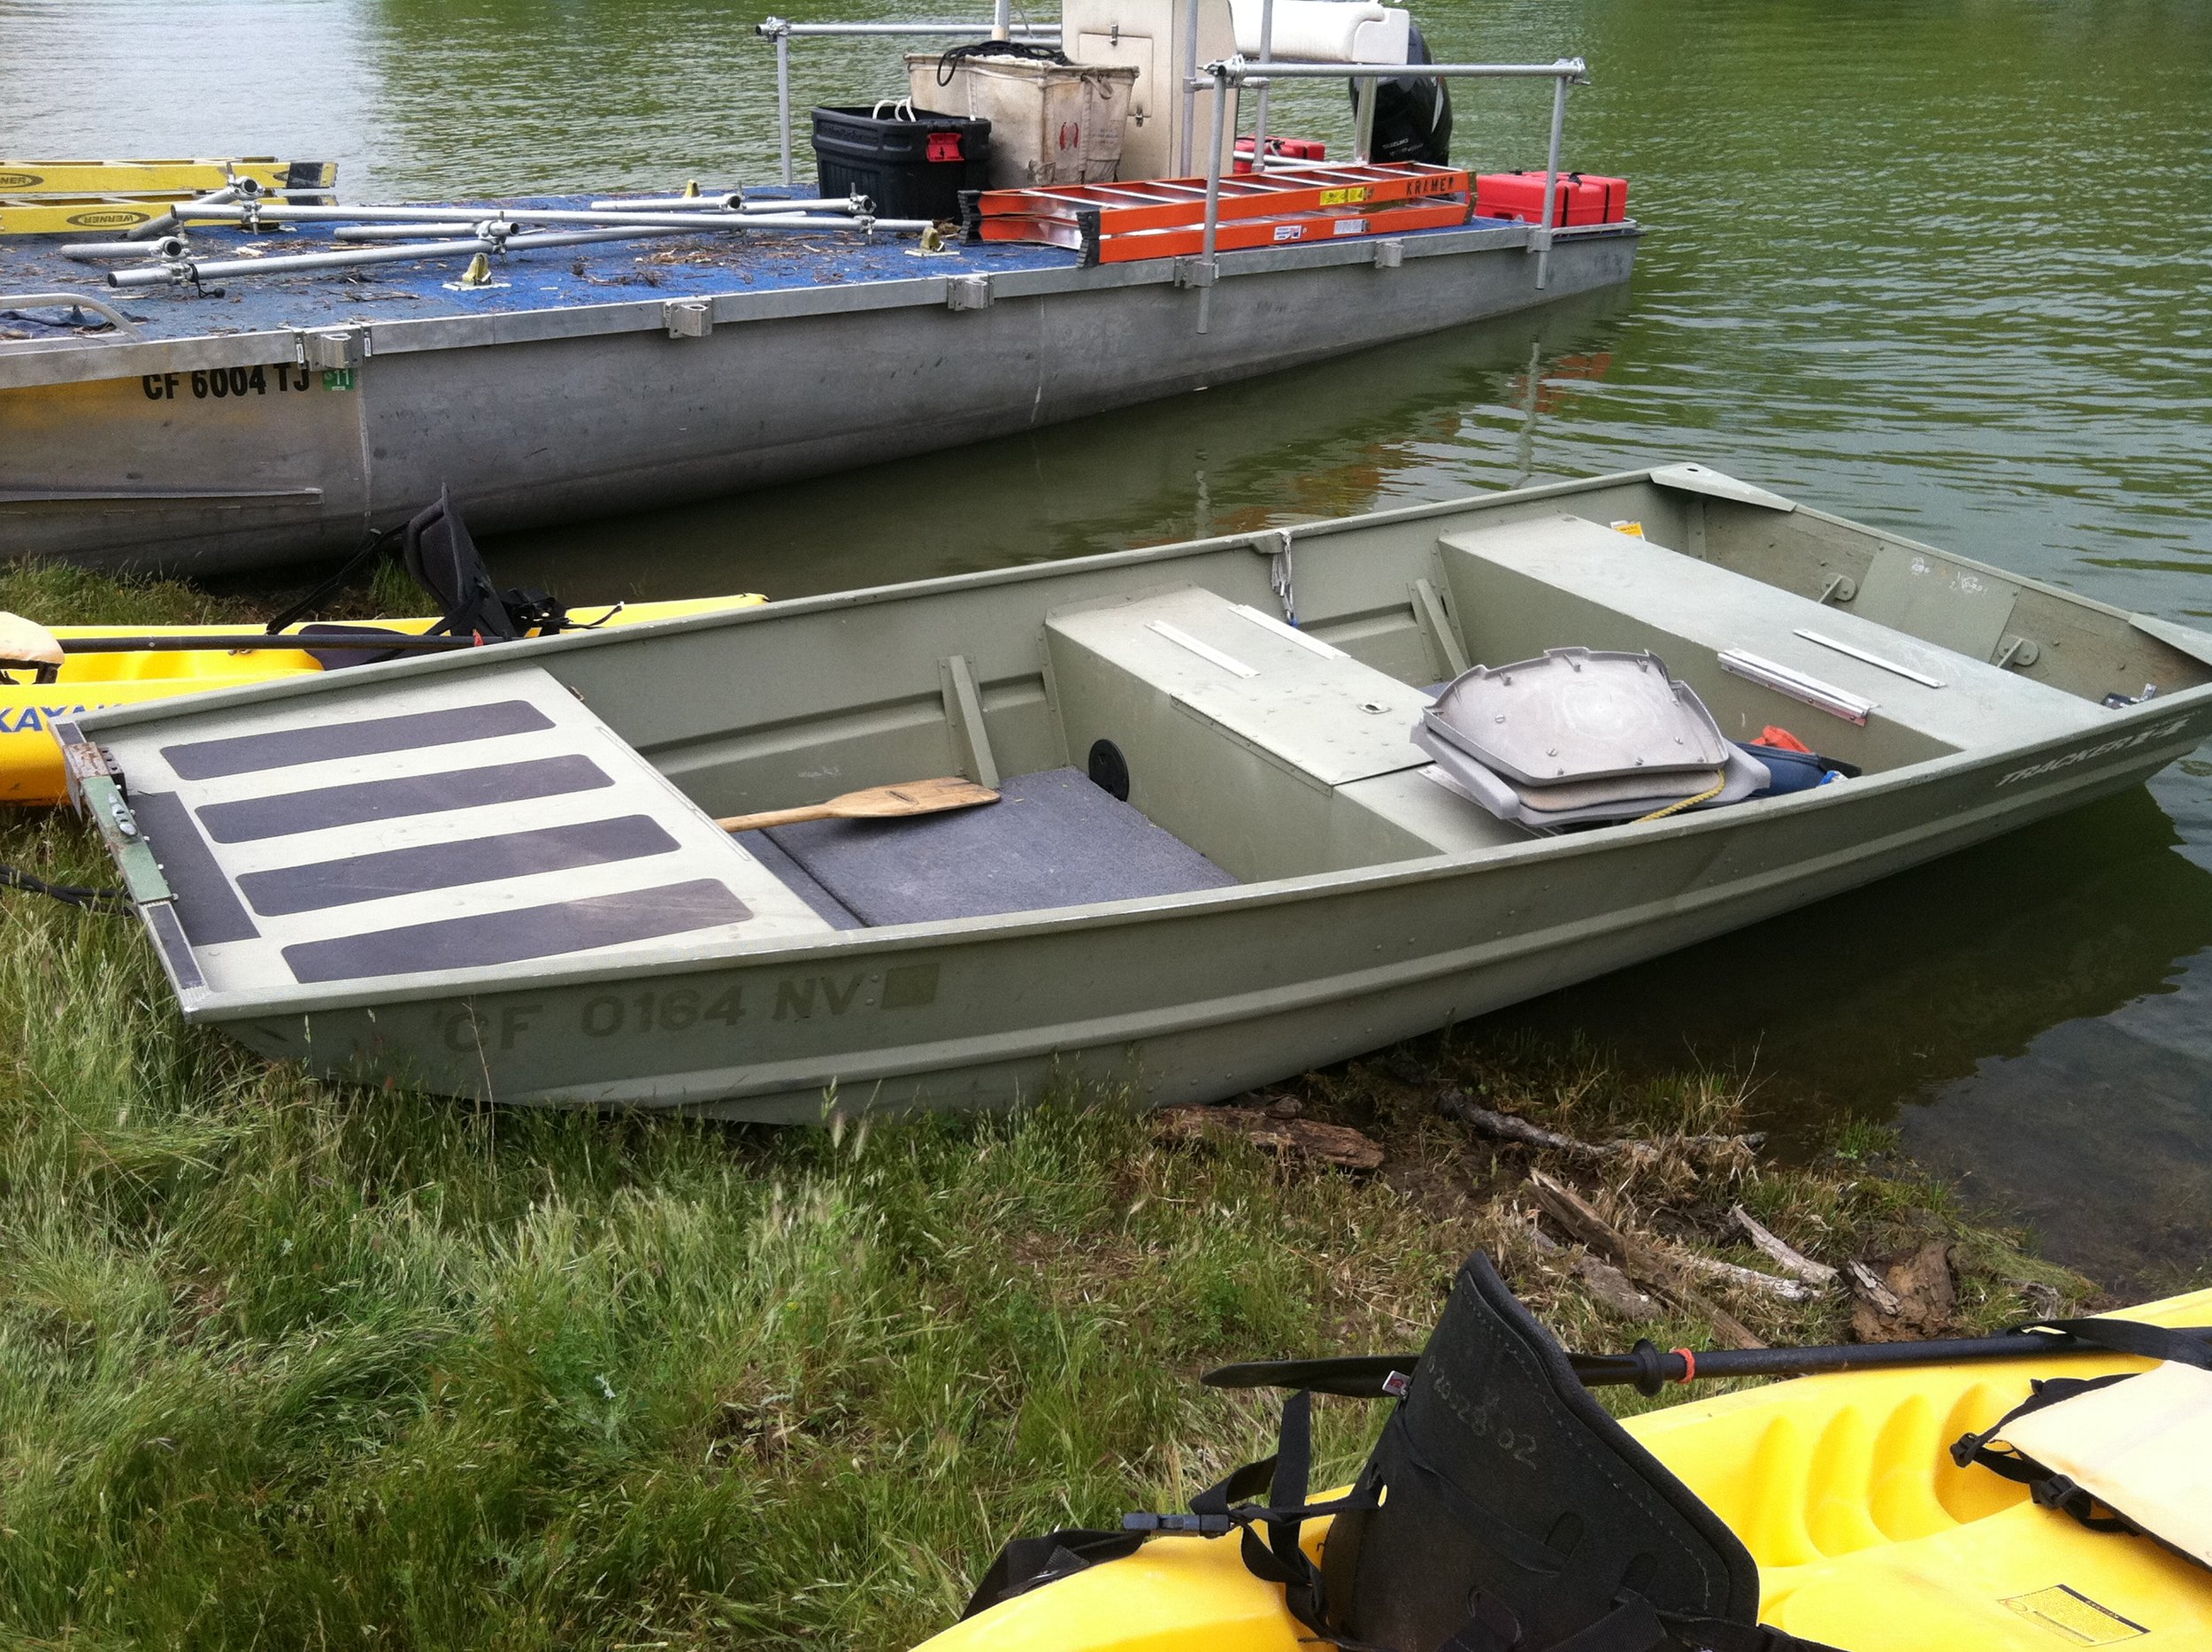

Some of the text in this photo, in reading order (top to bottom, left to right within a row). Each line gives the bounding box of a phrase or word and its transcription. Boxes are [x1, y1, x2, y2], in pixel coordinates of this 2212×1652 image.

[1406, 176, 1454, 196] KRAMER
[142, 361, 310, 400] CF 6004 TJ
[1995, 735, 2133, 788] TRACKER
[443, 975, 861, 1054] CF 0164 NV
